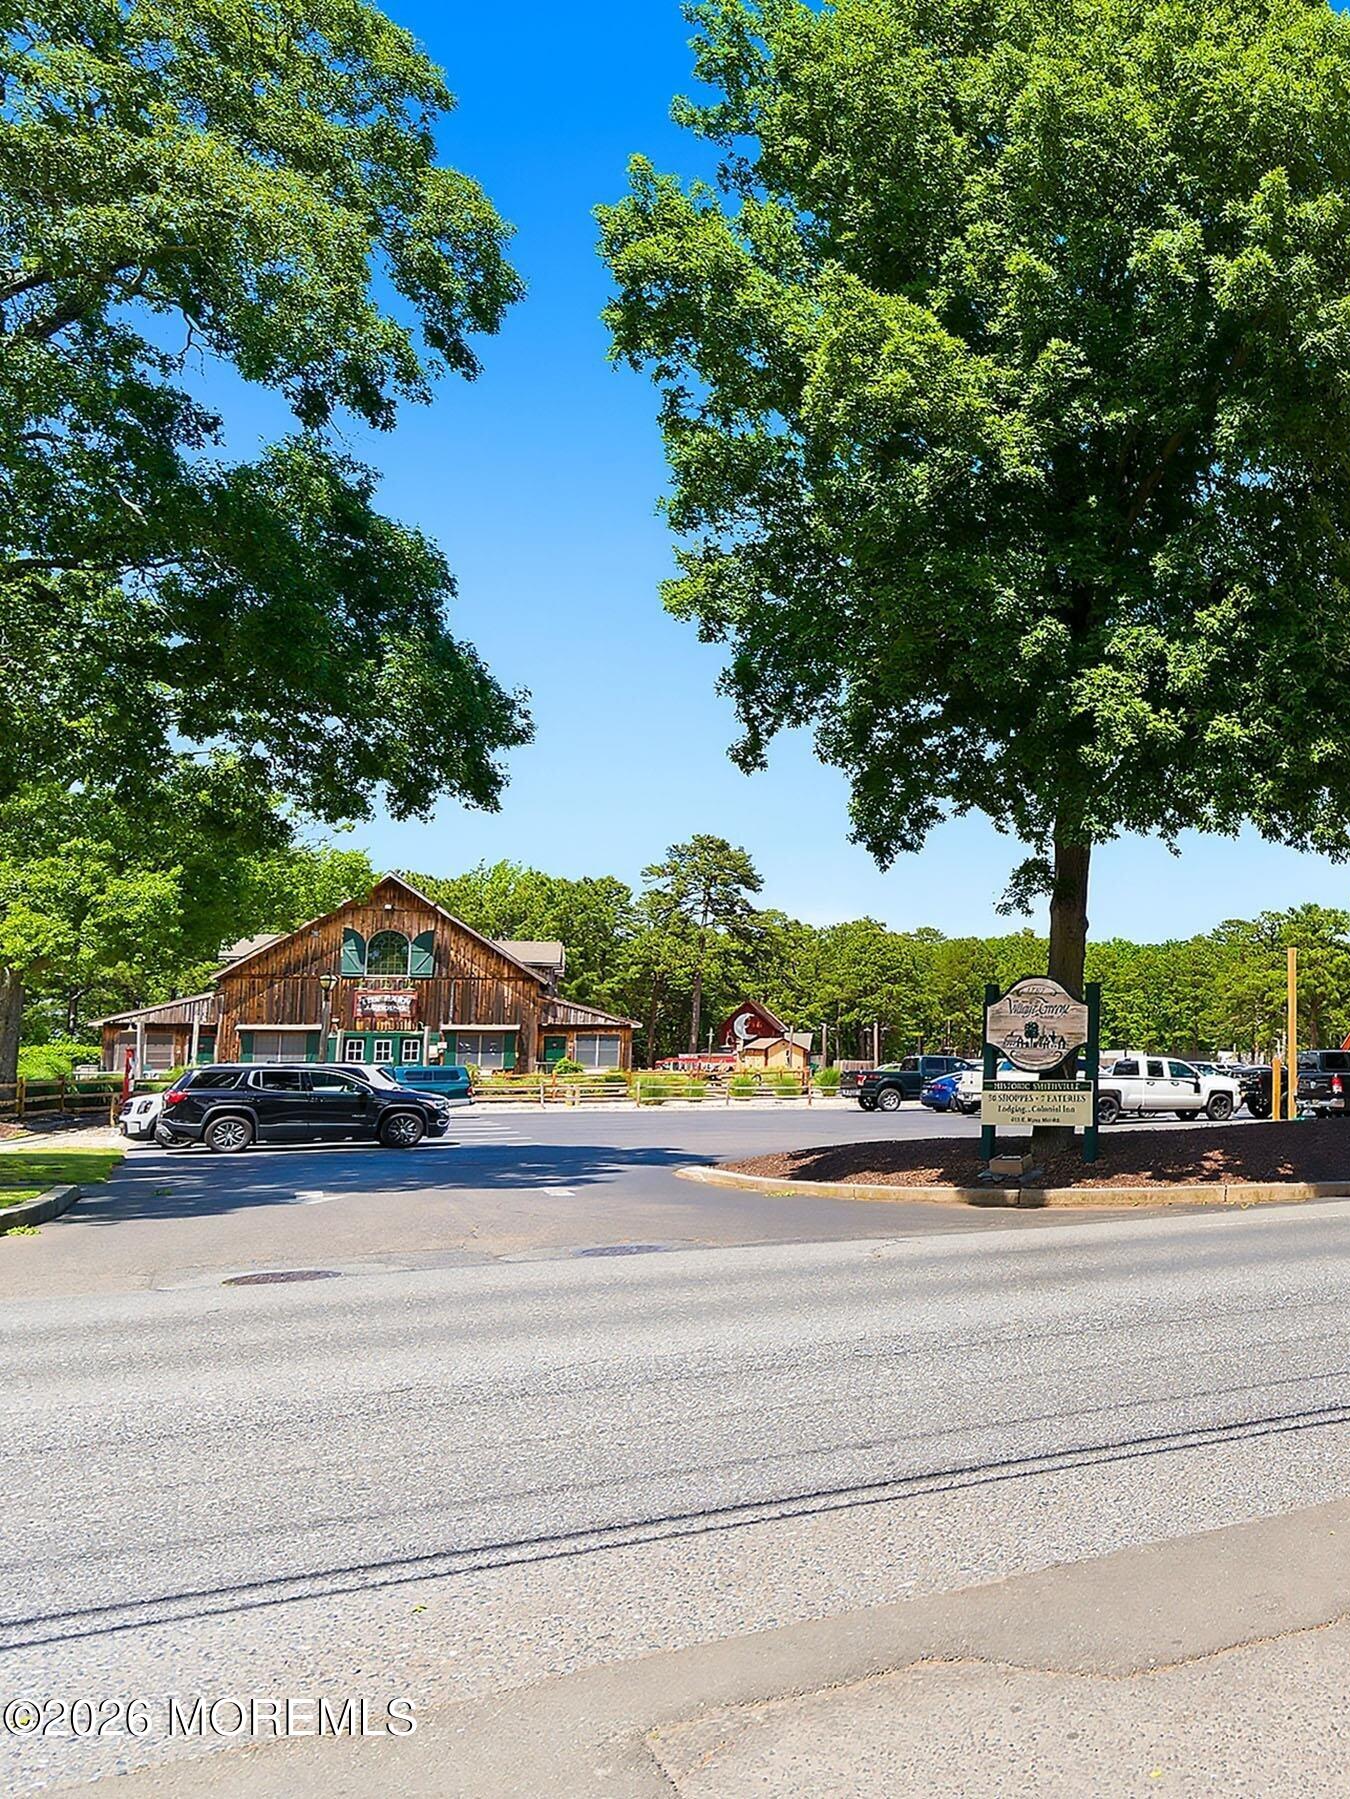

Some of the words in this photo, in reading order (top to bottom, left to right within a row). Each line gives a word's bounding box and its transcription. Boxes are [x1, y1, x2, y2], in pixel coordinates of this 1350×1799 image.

[993, 1082, 1031, 1090] HISTORIC
[1032, 1082, 1081, 1090] SMITHVILLE
[998, 1094, 1034, 1102] SHOPPES
[1047, 1094, 1086, 1102] EATERIES
